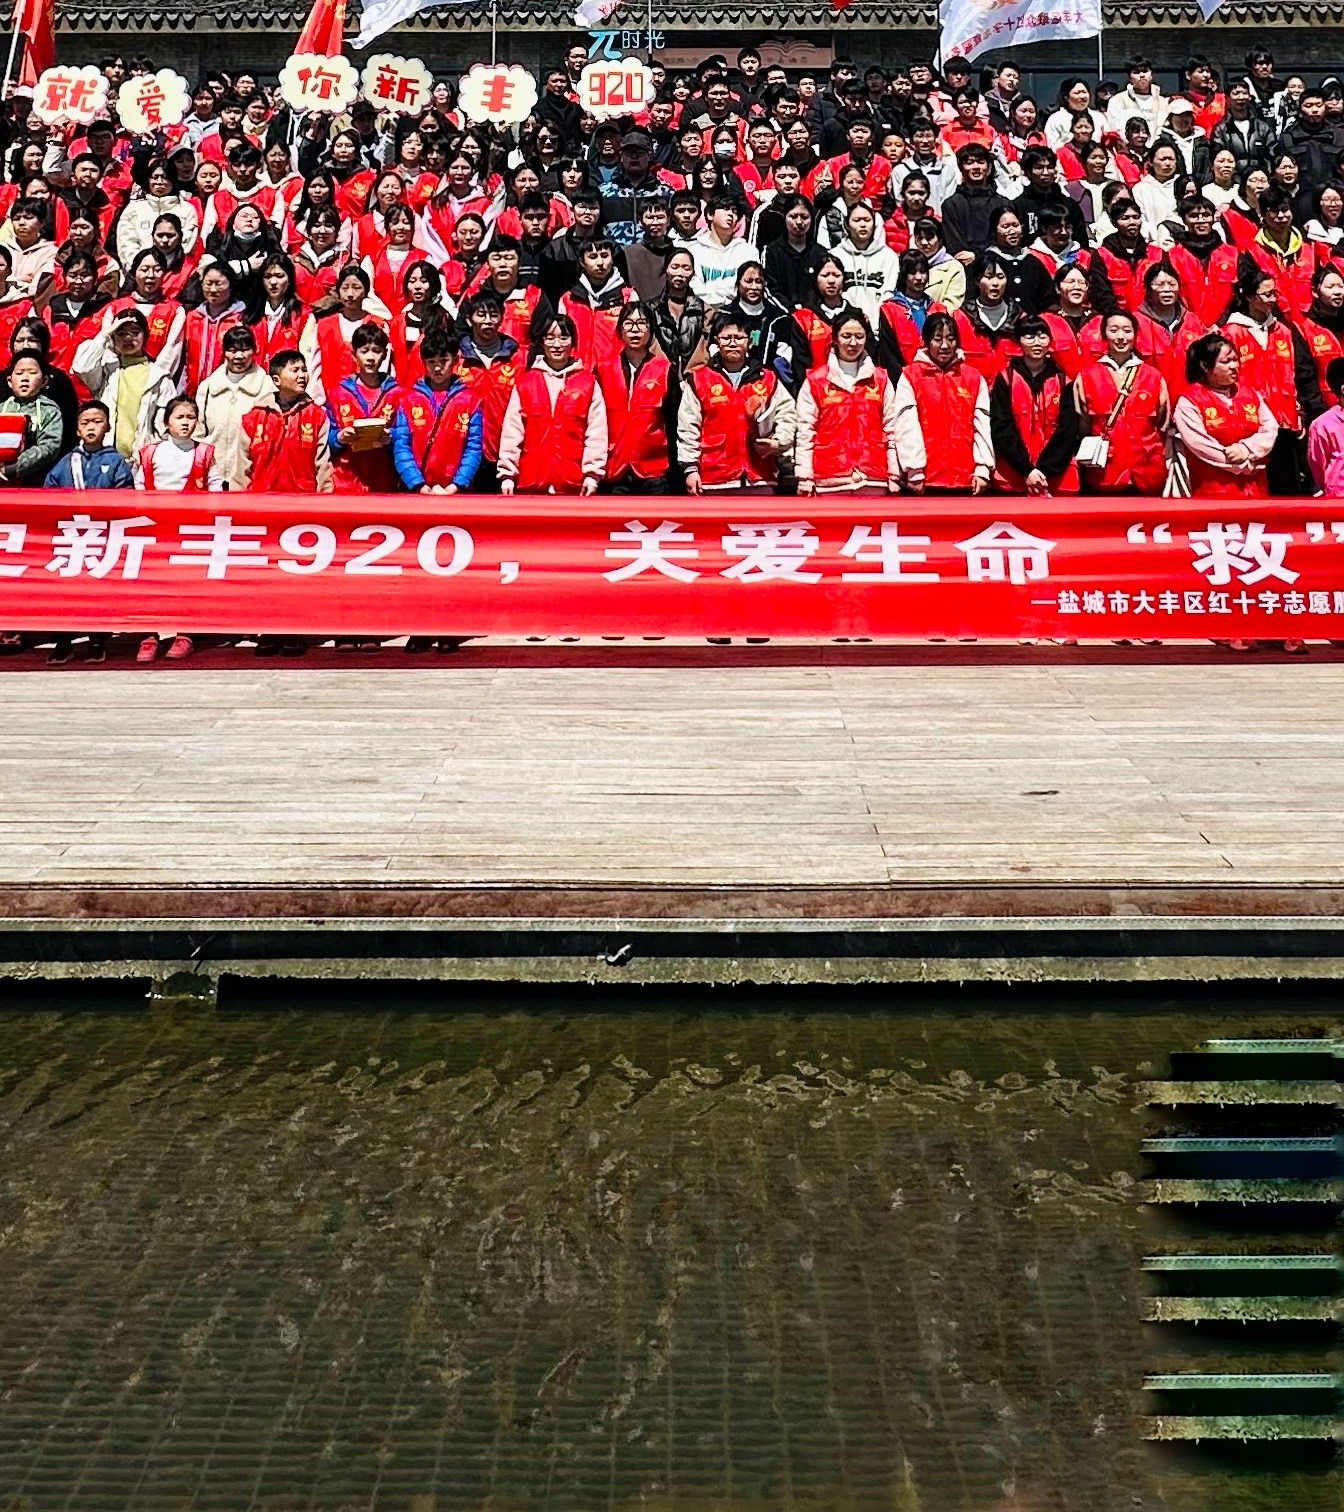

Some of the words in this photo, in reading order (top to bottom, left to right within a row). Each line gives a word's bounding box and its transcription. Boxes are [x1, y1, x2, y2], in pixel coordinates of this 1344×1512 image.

[40, 74, 96, 112] 就
[135, 78, 166, 128] 爱
[297, 65, 343, 100] 你
[373, 64, 421, 107] 新
[481, 74, 517, 114] 丰
[588, 71, 645, 106] 920
